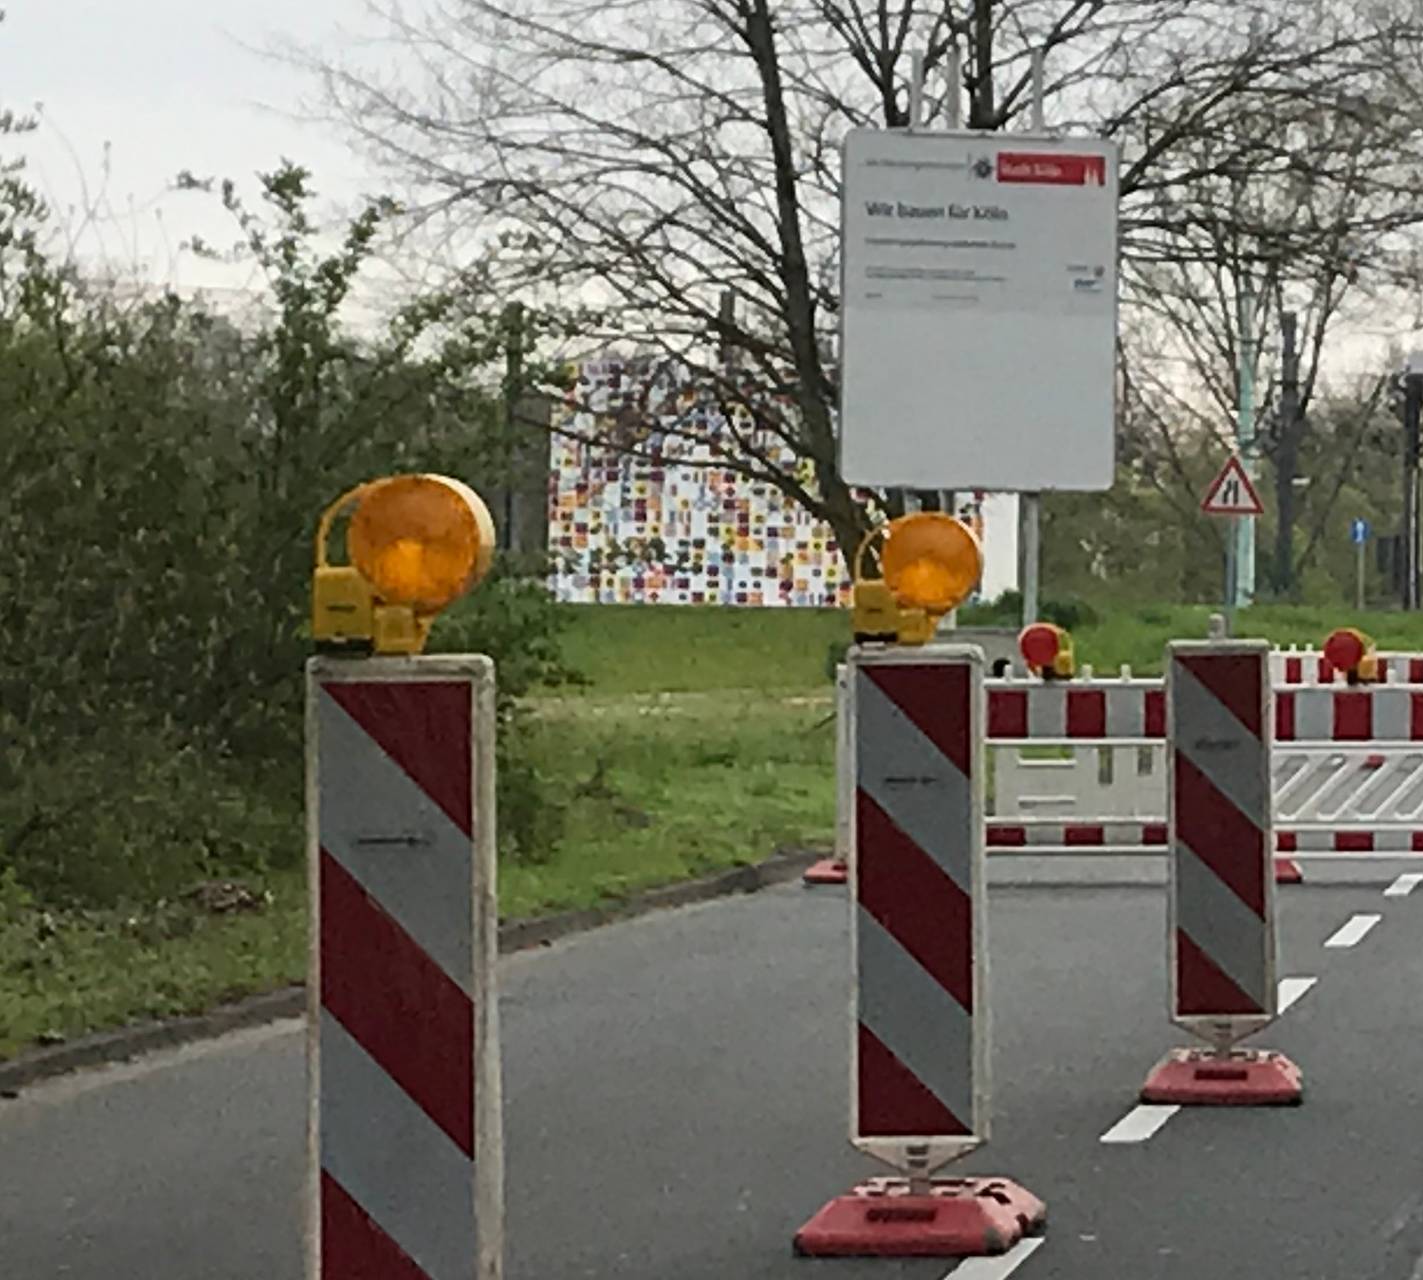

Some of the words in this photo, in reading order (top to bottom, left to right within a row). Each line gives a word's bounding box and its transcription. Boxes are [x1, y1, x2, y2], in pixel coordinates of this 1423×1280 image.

[866, 202, 894, 217] Wir
[897, 202, 945, 218] bauen
[949, 203, 970, 219] für
[973, 204, 1009, 221] Köln
